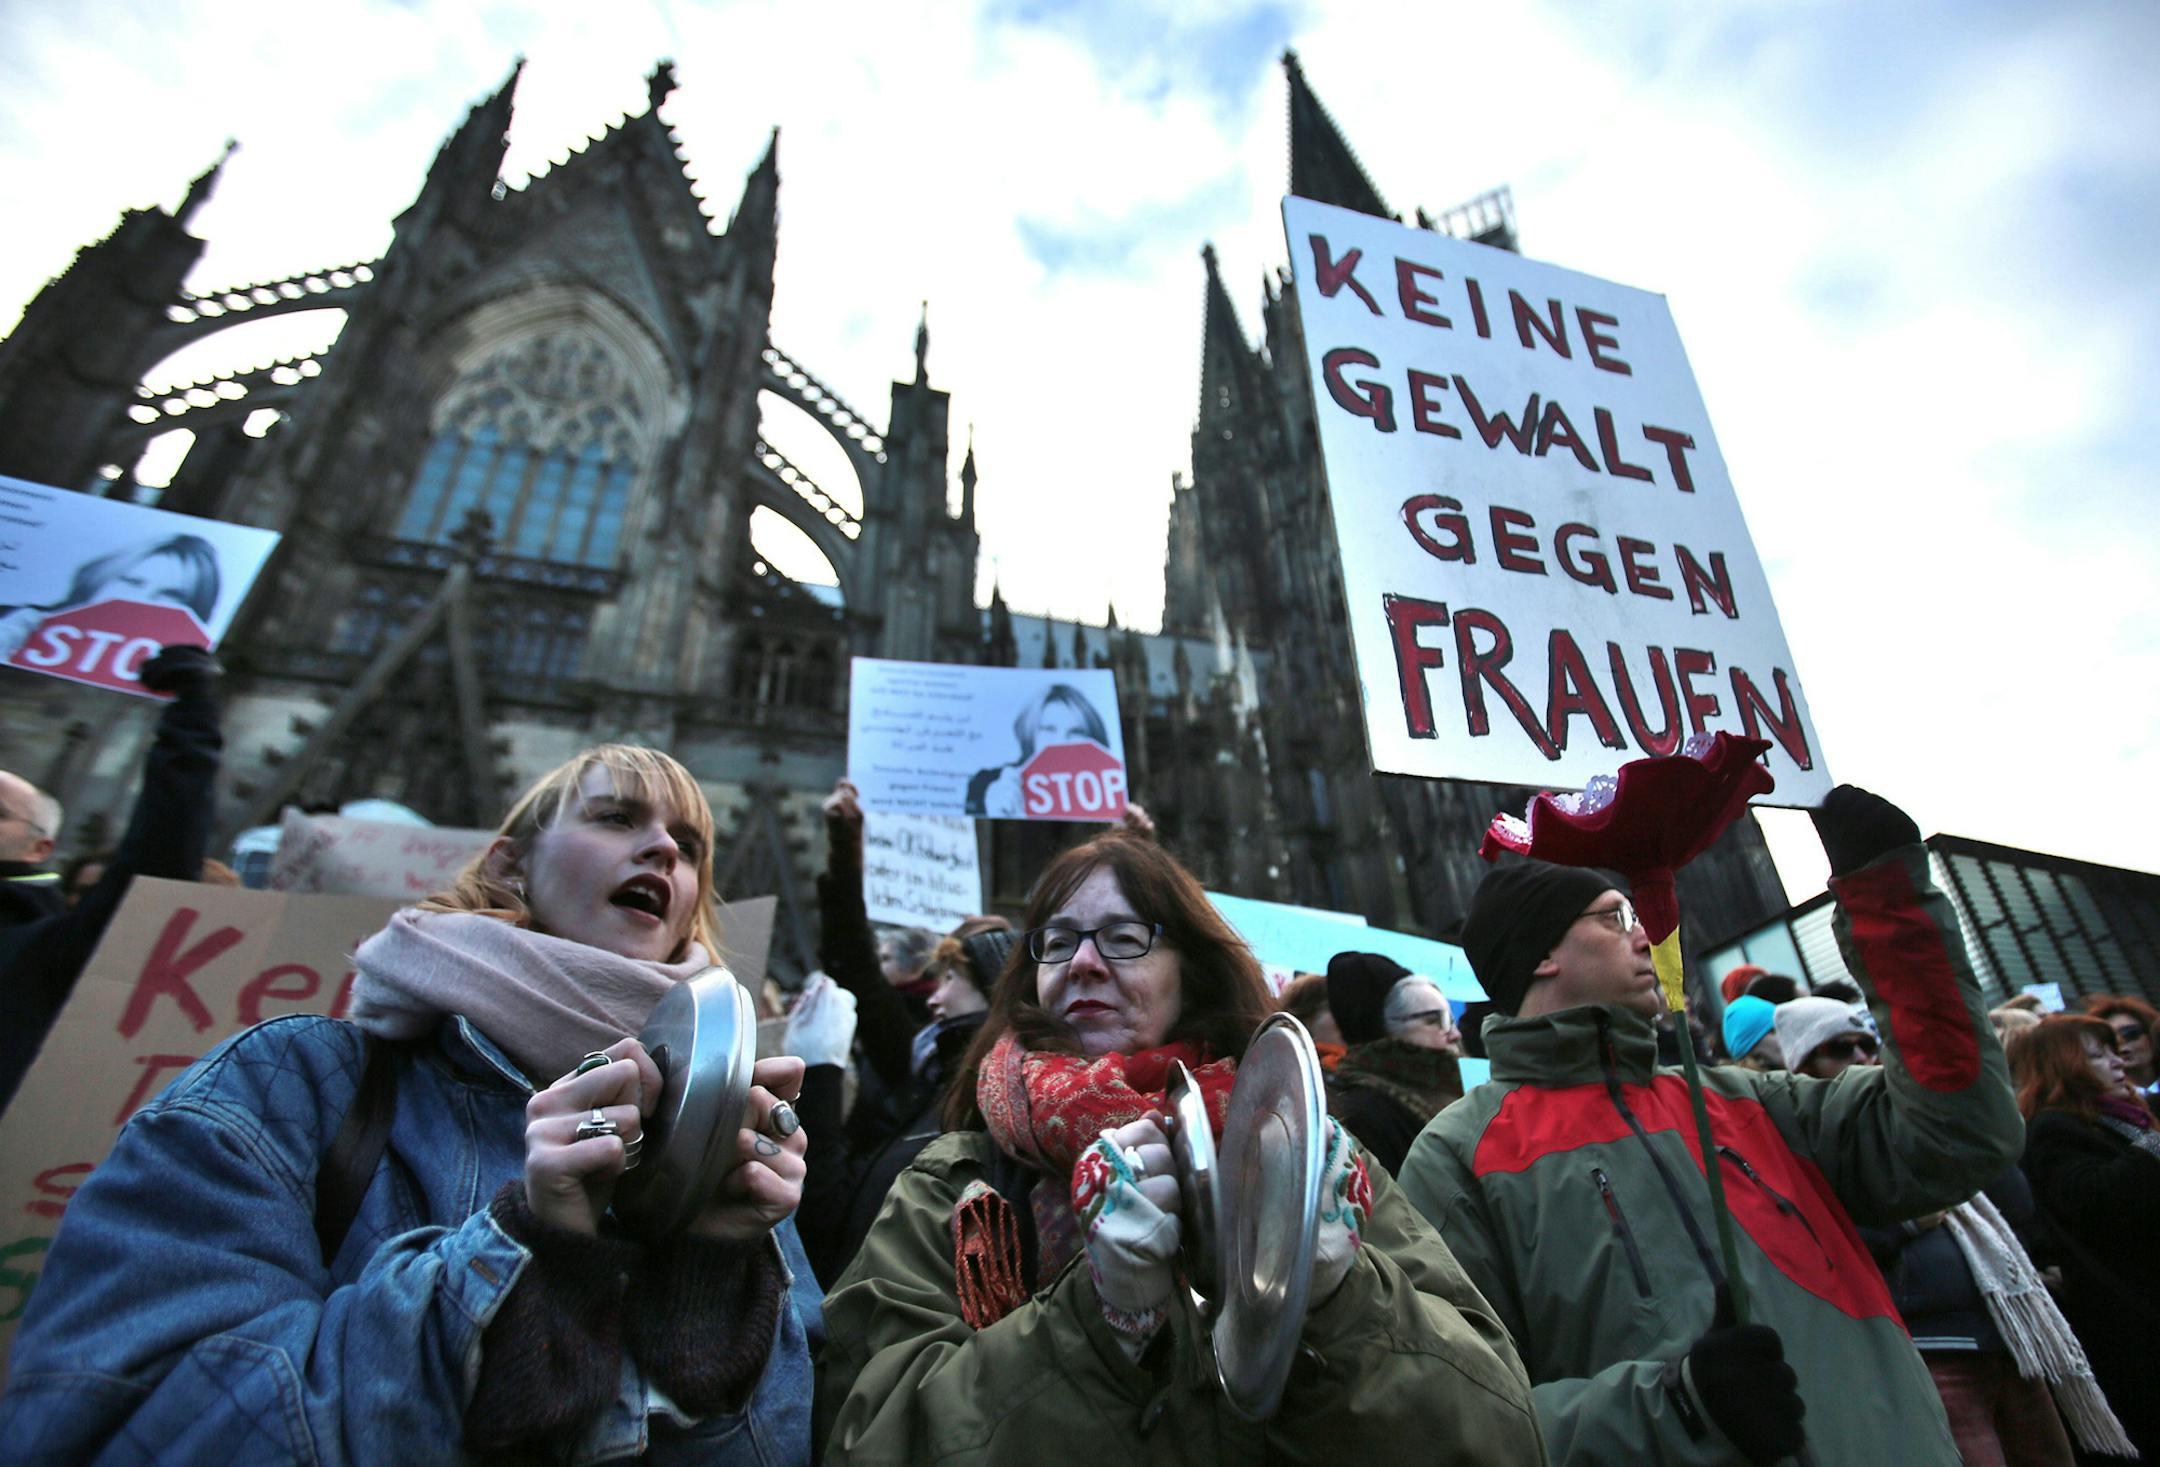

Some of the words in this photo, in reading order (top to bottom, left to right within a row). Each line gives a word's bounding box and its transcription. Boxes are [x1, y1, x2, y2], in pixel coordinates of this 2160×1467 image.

[1308, 234, 1632, 376] KEINE
[1321, 347, 1696, 494] GEWALT
[1400, 493, 1740, 620] GEGEN
[24, 623, 164, 681] STO
[1382, 592, 1814, 772] FRAUEN
[1026, 769, 1125, 815] STOP
[116, 906, 361, 1040] Kei
